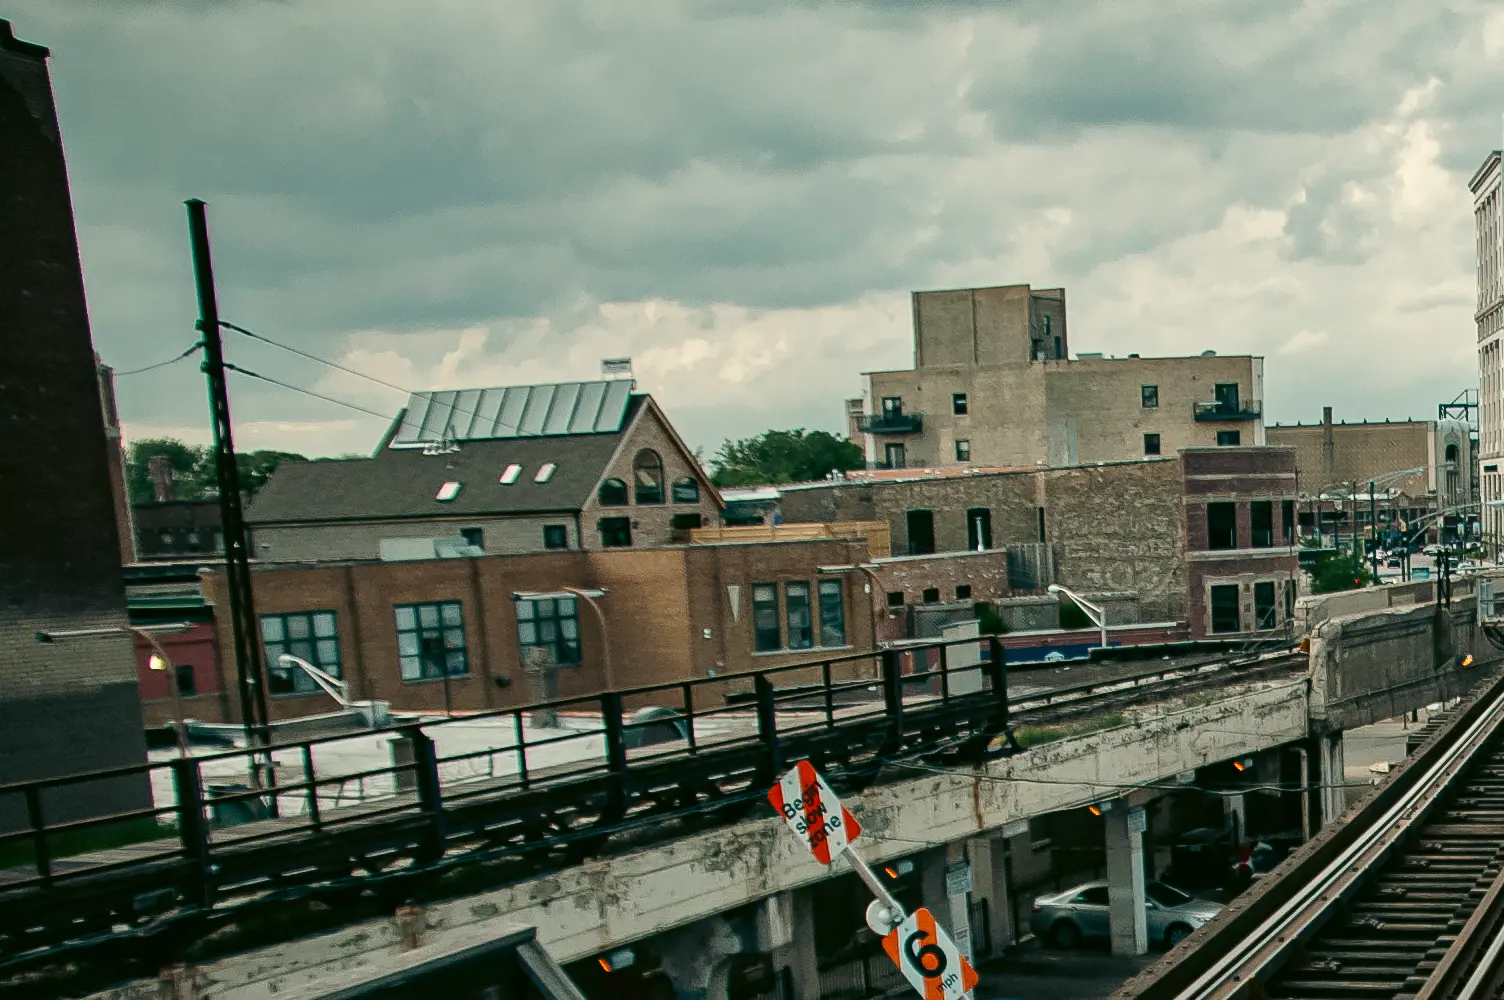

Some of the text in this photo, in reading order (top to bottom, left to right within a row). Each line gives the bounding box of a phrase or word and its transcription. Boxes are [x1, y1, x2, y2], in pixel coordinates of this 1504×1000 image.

[783, 780, 824, 819] Begin
[796, 802, 827, 834] slow
[807, 815, 842, 848] zone
[904, 930, 947, 978] 6
[936, 973, 959, 993] mph
